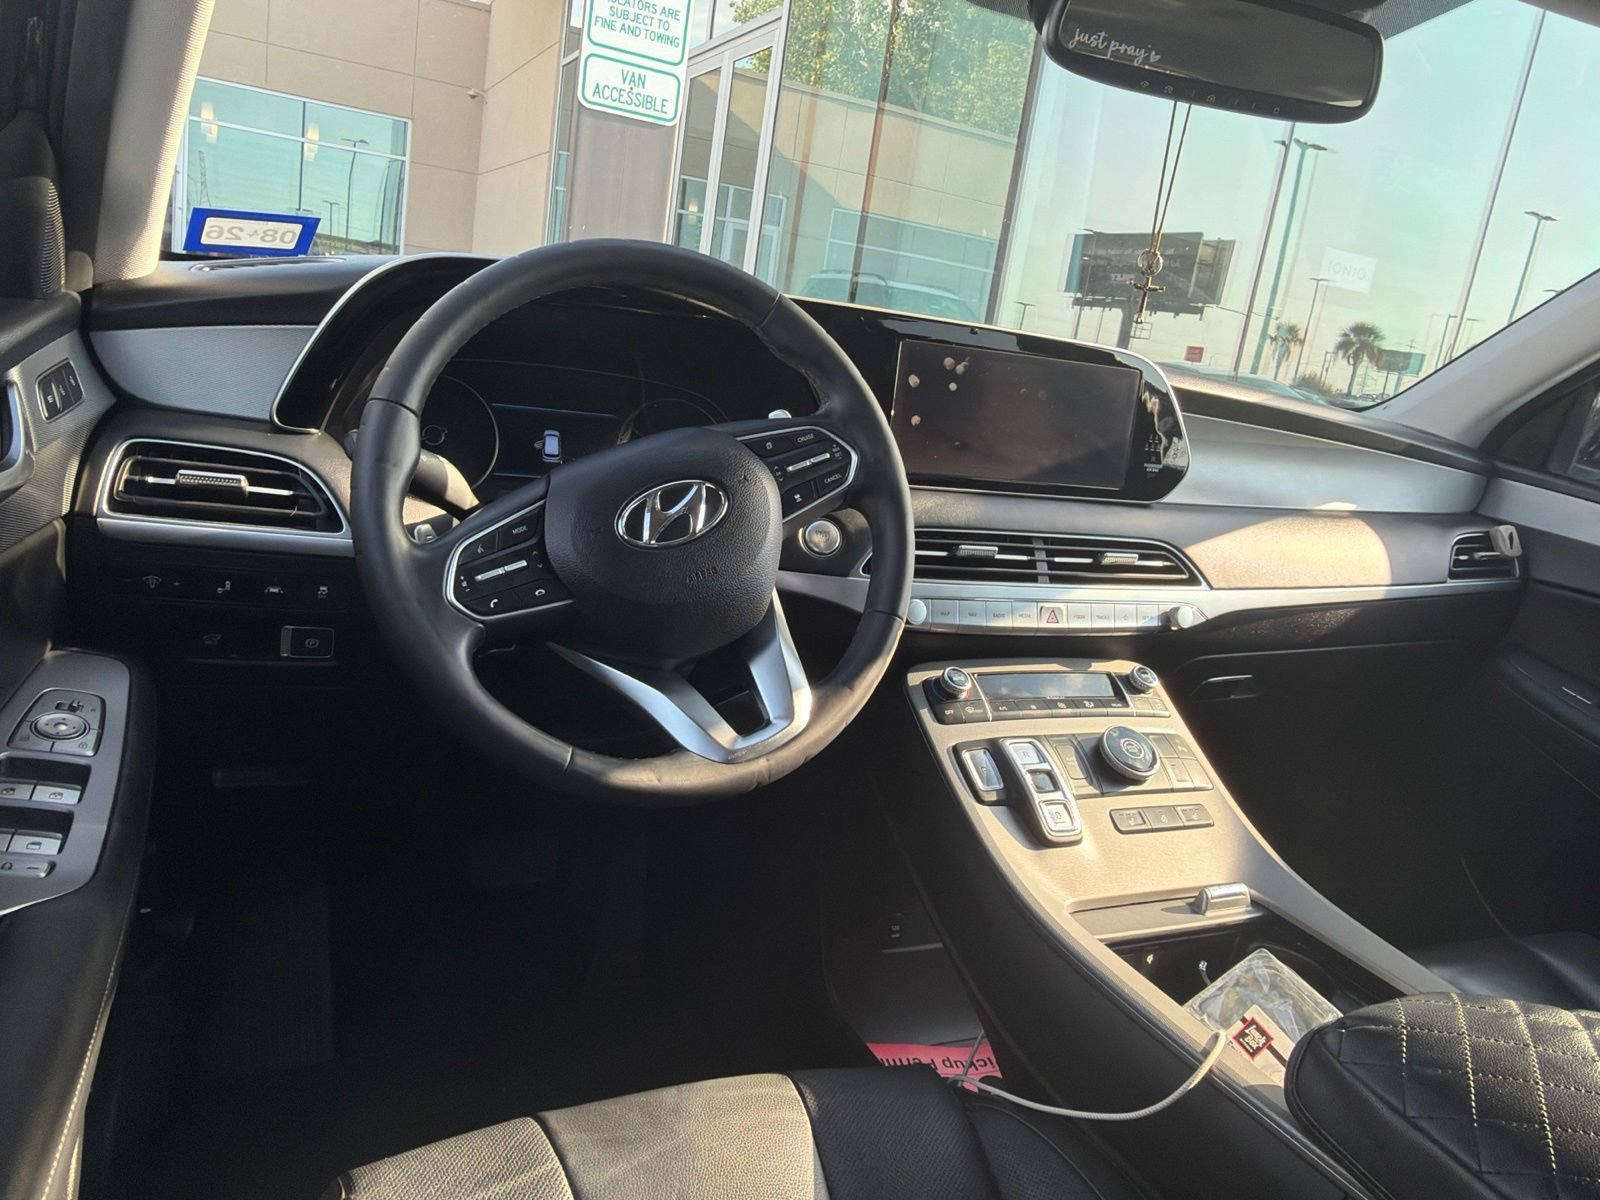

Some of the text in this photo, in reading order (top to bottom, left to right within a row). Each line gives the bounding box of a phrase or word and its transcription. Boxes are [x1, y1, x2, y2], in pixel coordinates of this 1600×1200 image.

[609, 5, 670, 31] SUBJECT TO
[659, 6, 681, 21] ARE
[594, 15, 680, 48] FINE AND TOWING
[1068, 28, 1149, 65] just pray
[621, 69, 646, 89] VAN
[592, 82, 669, 114] ACCESSIBLE
